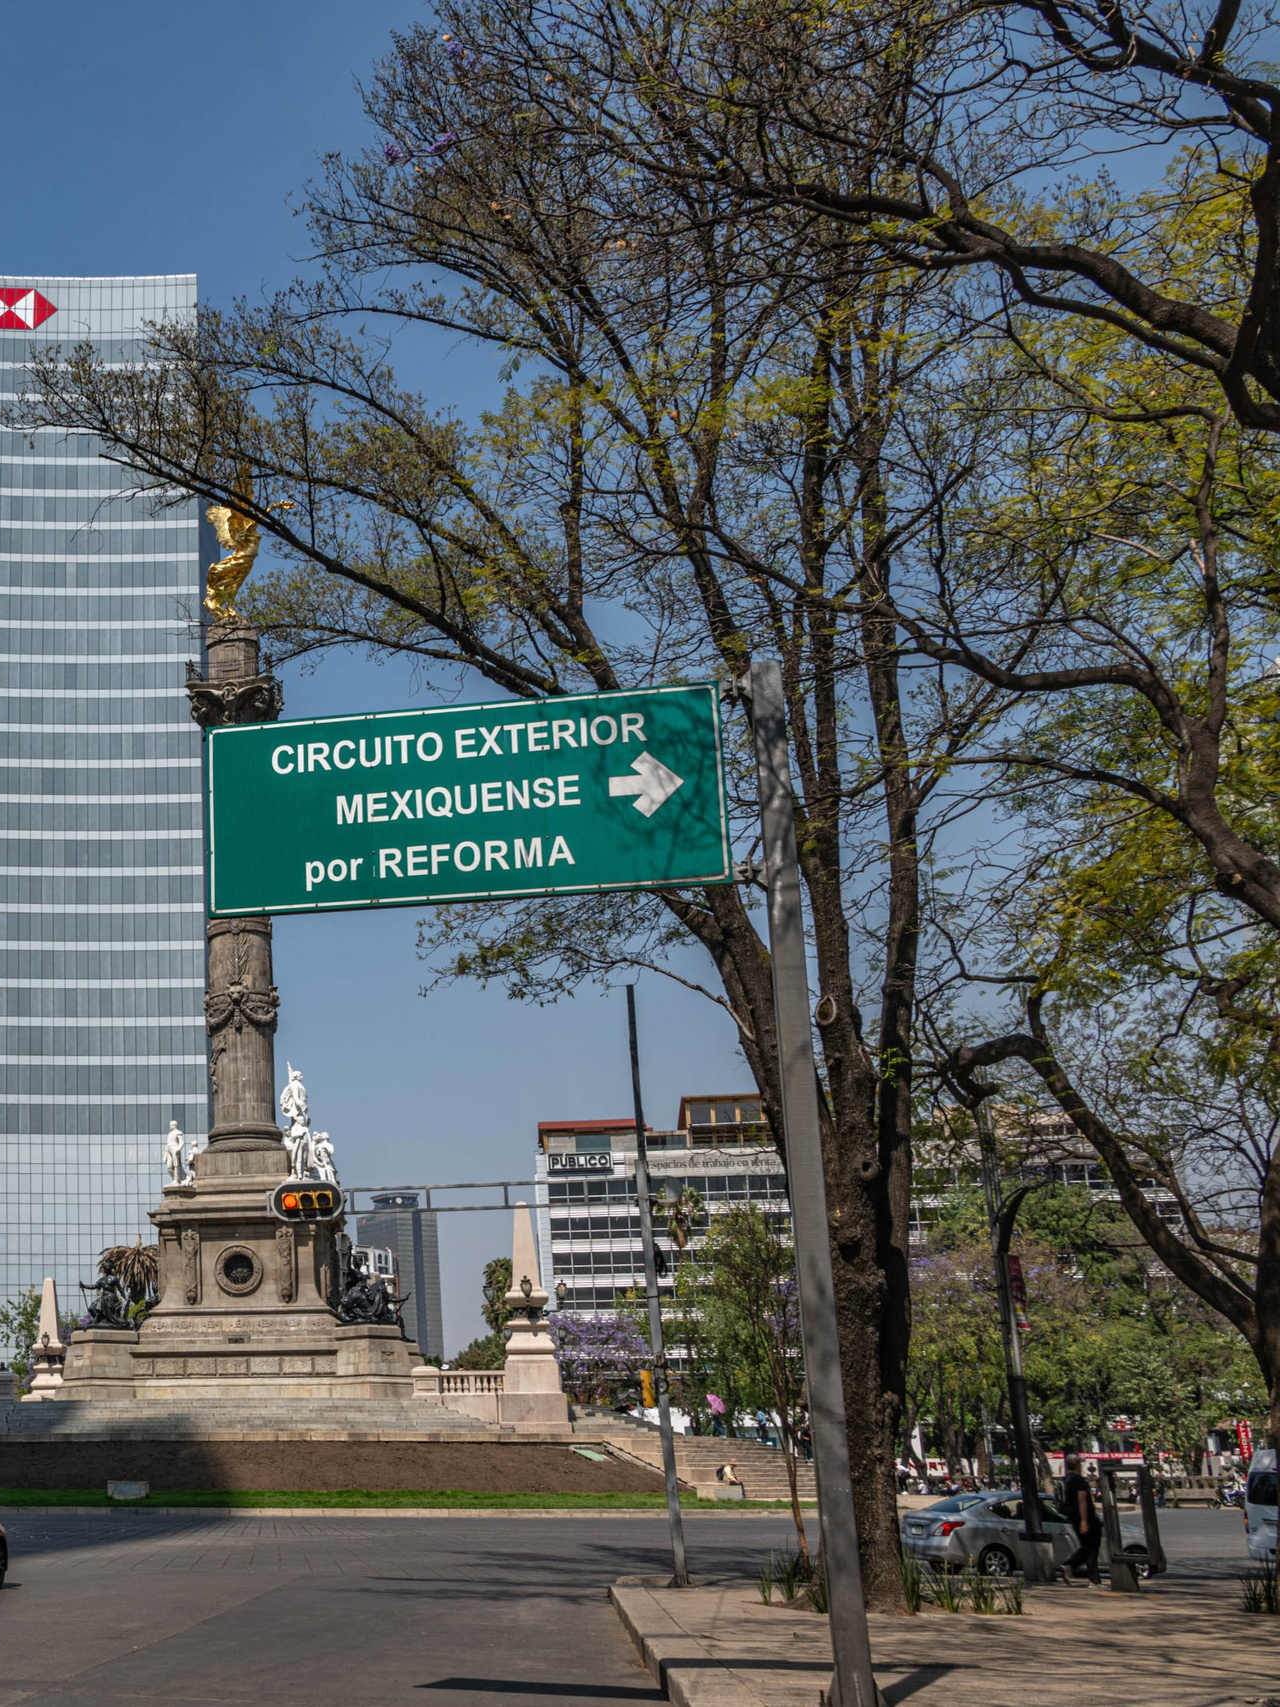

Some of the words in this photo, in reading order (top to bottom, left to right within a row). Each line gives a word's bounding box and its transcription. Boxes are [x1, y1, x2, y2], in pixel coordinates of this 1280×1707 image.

[271, 731, 443, 774] CIRCUITO
[455, 712, 648, 759] EXTERIOR
[336, 774, 581, 825] MEXIQUENSE
[305, 857, 364, 891] por
[378, 835, 576, 879] REFORMA
[551, 1153, 608, 1168] PÚBLICO
[647, 1160, 687, 1171] Espacios
[689, 1157, 700, 1168] de
[702, 1159, 735, 1169] trabajo
